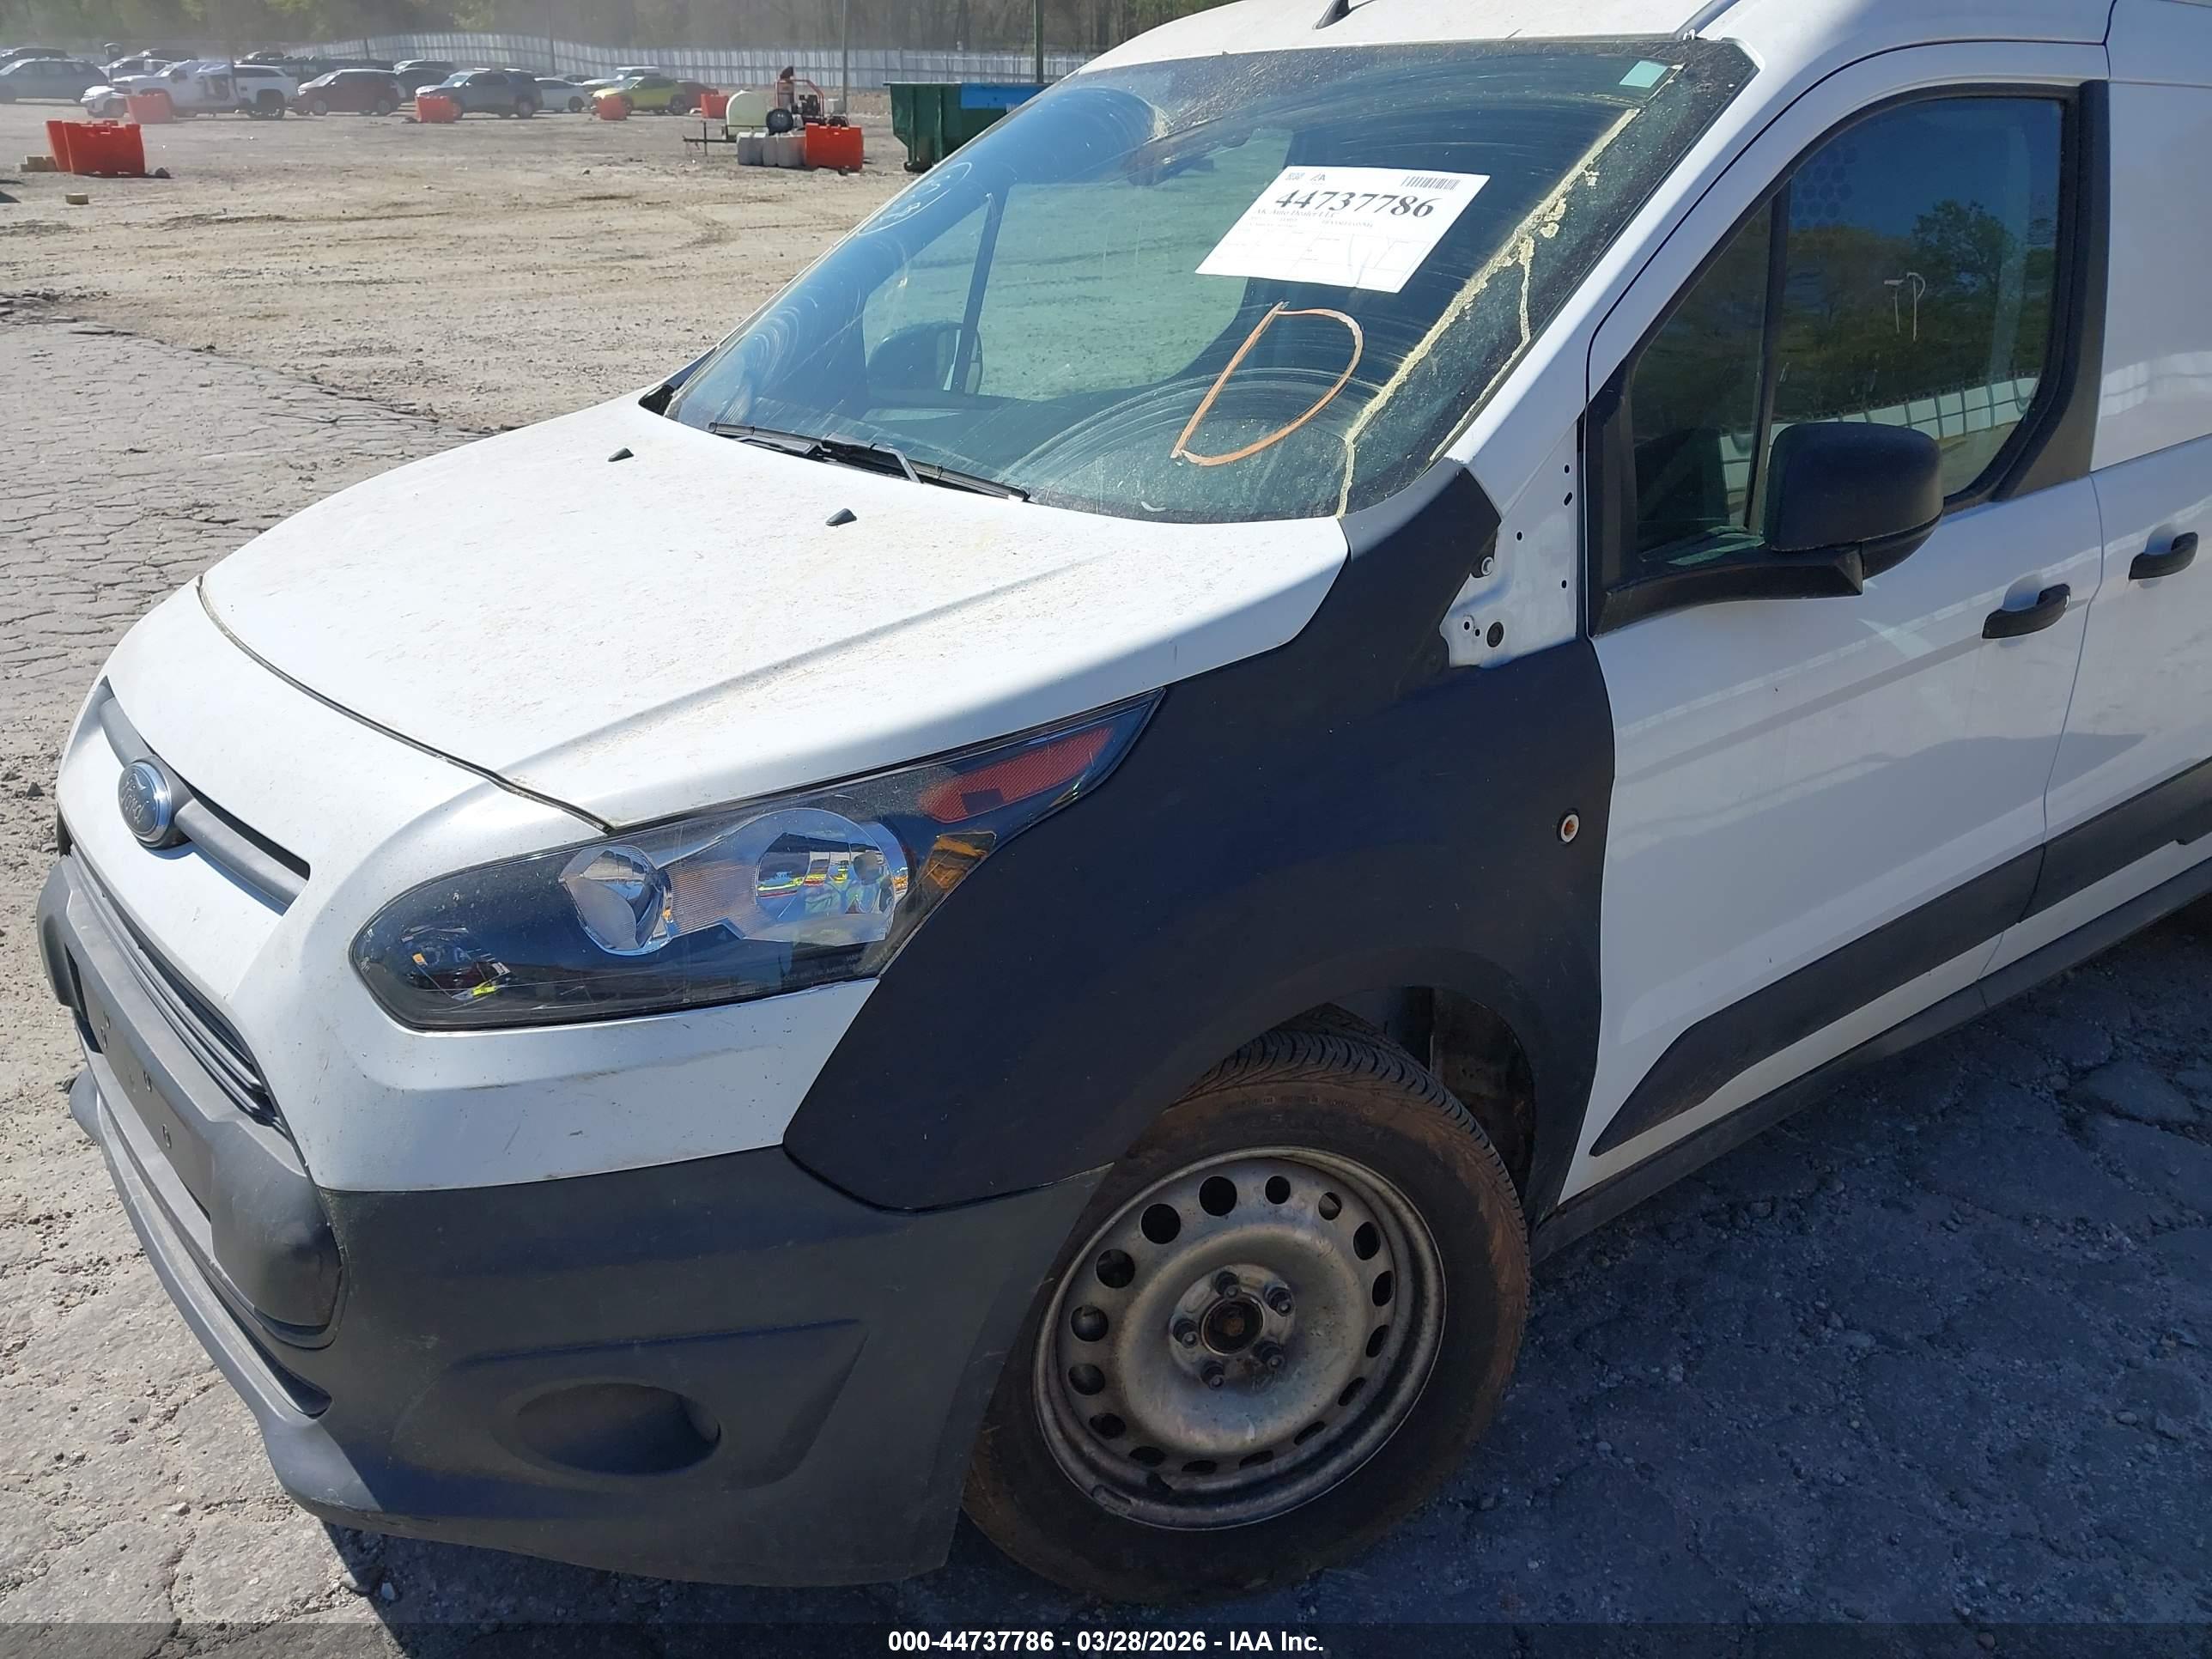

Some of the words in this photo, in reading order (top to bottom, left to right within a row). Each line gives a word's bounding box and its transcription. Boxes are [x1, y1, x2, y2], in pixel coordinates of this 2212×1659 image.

[1276, 190, 1442, 217] 44737786
[1170, 301, 1364, 466] D
[121, 772, 149, 825] Ford
